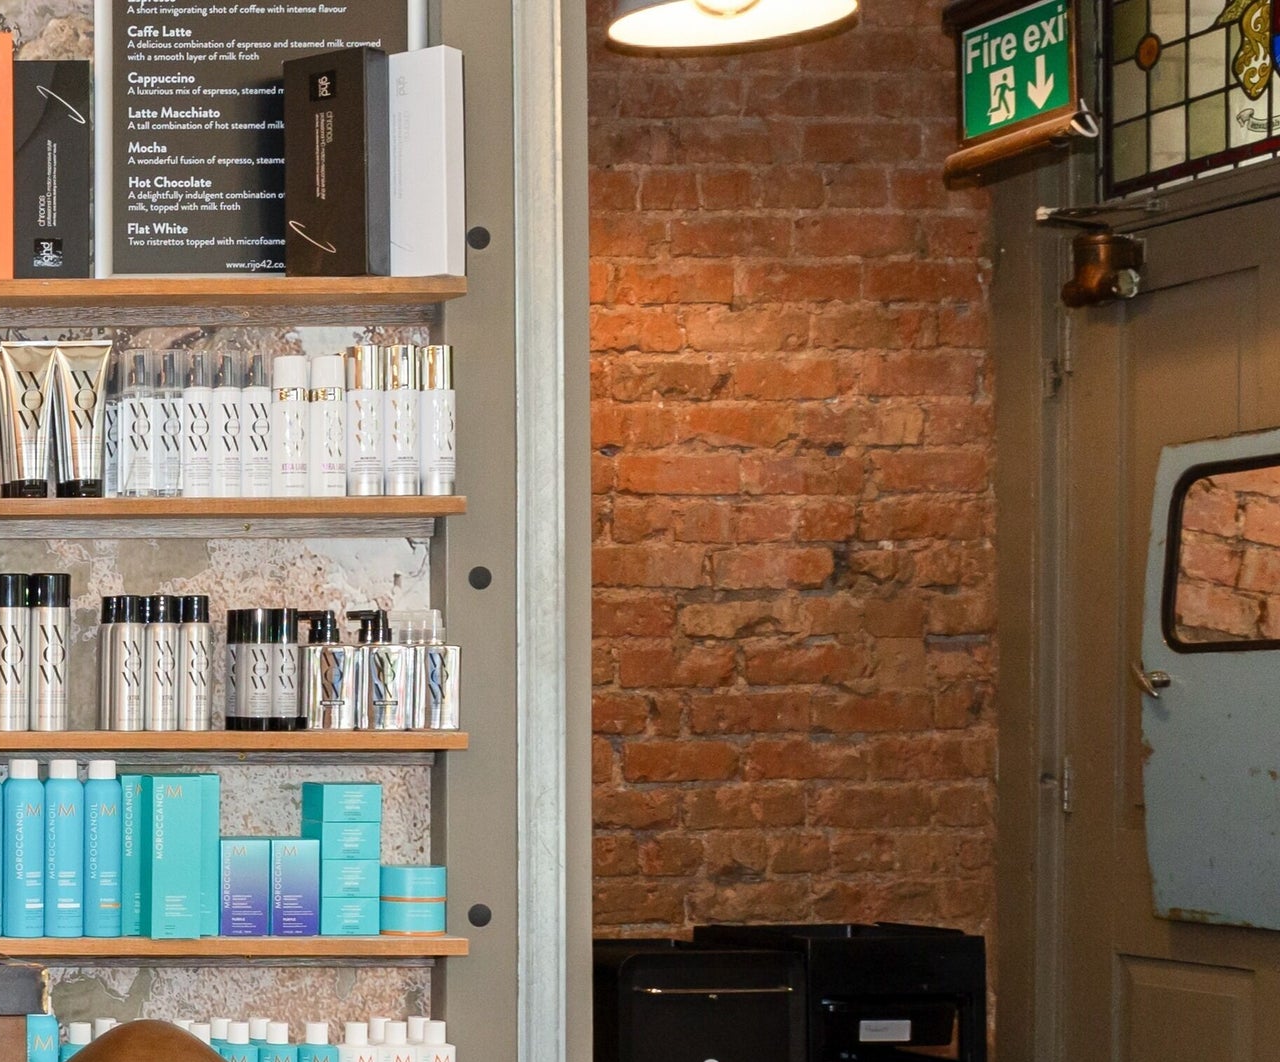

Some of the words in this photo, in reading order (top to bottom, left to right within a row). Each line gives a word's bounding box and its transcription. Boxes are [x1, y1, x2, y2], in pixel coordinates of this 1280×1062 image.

[126, 6, 136, 14] A
[136, 4, 158, 14] short
[159, 5, 208, 17] invigorating
[208, 5, 228, 13] shot
[228, 5, 239, 13] of
[239, 5, 266, 13] coffee
[266, 5, 286, 13] with
[286, 5, 317, 13] intense
[318, 4, 348, 13] flavour
[126, 26, 160, 37] Caffe
[162, 26, 193, 37] Latte
[126, 40, 136, 48] A
[136, 40, 173, 48] delicious
[173, 40, 225, 48] combination
[225, 39, 236, 48] of
[236, 42, 272, 51] espresso
[272, 39, 289, 48] and
[289, 39, 326, 48] steamed
[326, 39, 345, 47] milk
[345, 39, 382, 47] crowned
[127, 53, 146, 61] with
[153, 52, 185, 61] smooth
[186, 52, 207, 63] layer
[207, 52, 218, 60] of
[218, 52, 237, 60] milk
[238, 52, 260, 60] froth
[966, 32, 1017, 75] Fire
[127, 72, 196, 87] Cappuccino
[136, 85, 174, 95] luxurious
[174, 86, 191, 94] mix
[191, 86, 202, 94] of
[202, 89, 241, 97] espresso,
[241, 86, 277, 94] steamed
[319, 76, 330, 96] ghd
[396, 76, 407, 96] ghd
[127, 107, 159, 118] Latte
[160, 107, 221, 118] Macchiato
[127, 121, 136, 129] A
[136, 121, 150, 129] tall
[151, 121, 203, 129] combination
[203, 121, 214, 129] of
[214, 121, 230, 129] hot
[230, 121, 266, 129] steamed
[266, 121, 285, 129] milk
[325, 111, 334, 143] chronos
[127, 142, 168, 153] Mocha
[127, 156, 136, 164] A
[137, 156, 179, 164] wonderful
[179, 156, 206, 164] fusion
[206, 156, 217, 164] of
[217, 158, 255, 166] espresso,
[128, 177, 152, 188] Hot
[153, 176, 213, 188] Chocolate
[127, 191, 136, 199] A
[136, 191, 184, 204] delightfully
[185, 191, 225, 204] indulgent
[225, 190, 277, 199] combination
[37, 195, 46, 226] chronos
[127, 203, 149, 212] milk,
[149, 203, 180, 213] topped
[180, 202, 199, 210] with
[199, 202, 219, 210] milk
[219, 202, 242, 210] froth
[127, 223, 151, 234] Flat
[152, 223, 189, 234] White
[127, 237, 146, 245] Two
[146, 237, 185, 245] ristrettos
[185, 237, 216, 248] topped
[216, 237, 235, 245] with
[235, 237, 287, 245] microfoame
[41, 242, 53, 262] ghd
[225, 260, 288, 271] www.rijo42.co.
[156, 784, 165, 860] MOROCCANOIL
[16, 802, 24, 880] MOROCCANOIL
[90, 802, 98, 880] MOROCCANOIL
